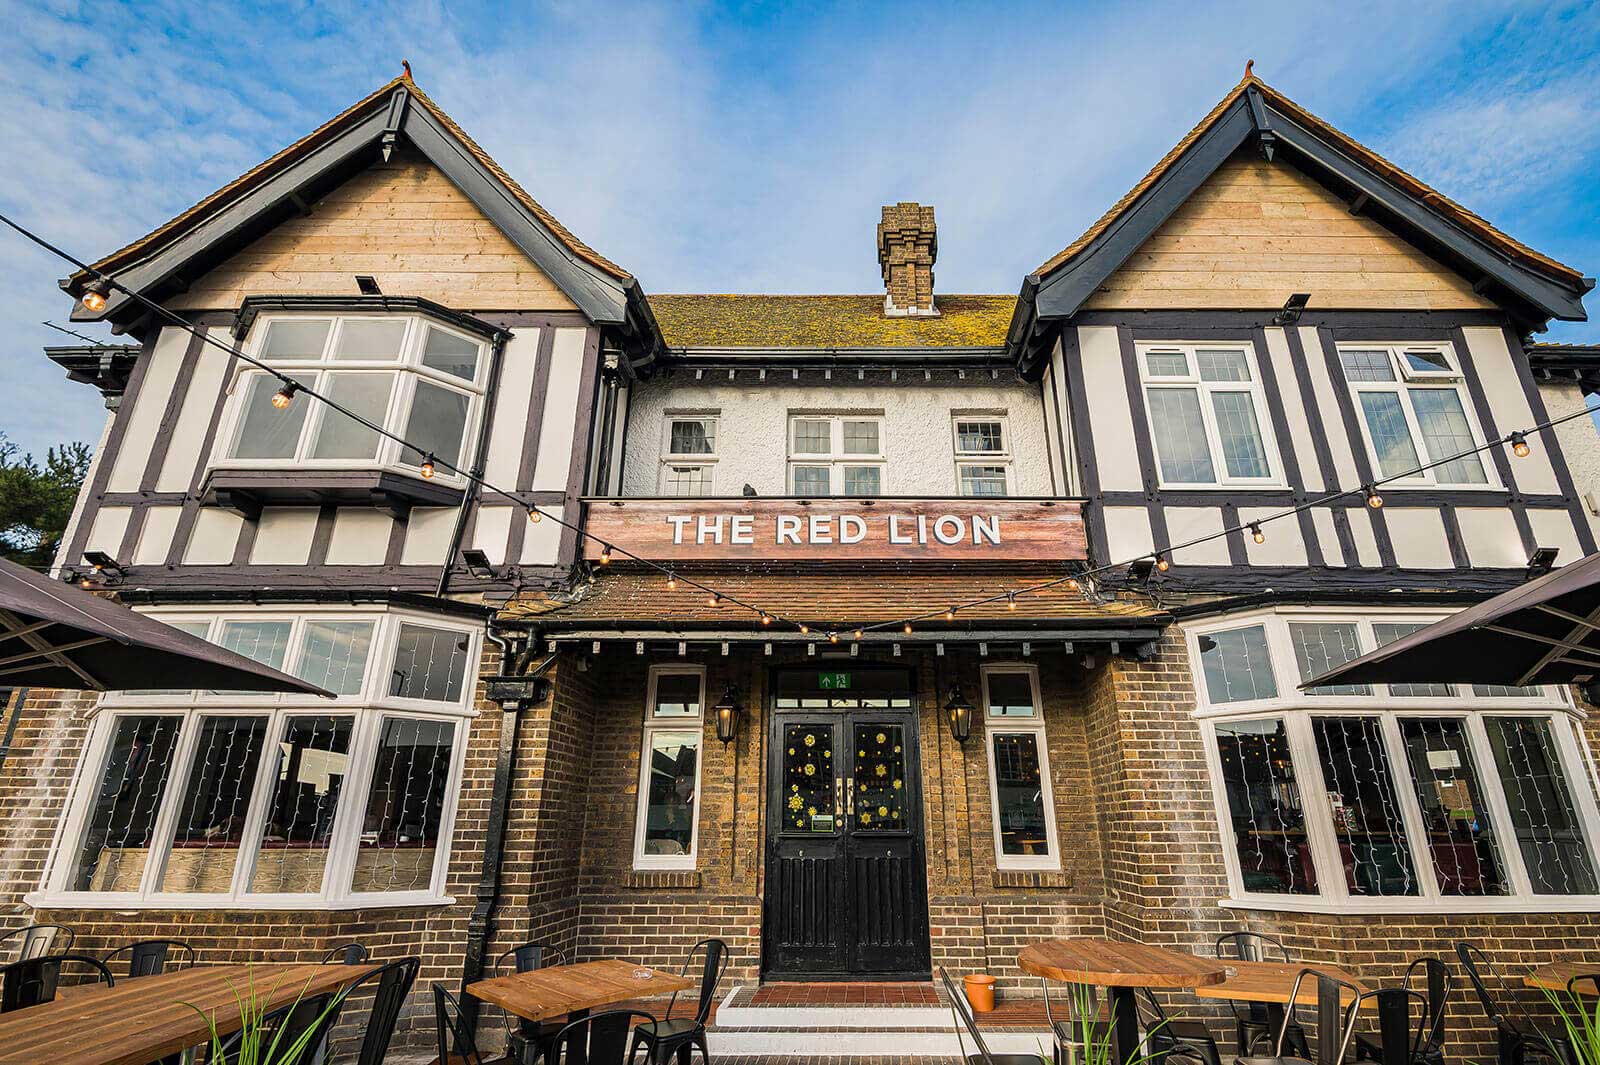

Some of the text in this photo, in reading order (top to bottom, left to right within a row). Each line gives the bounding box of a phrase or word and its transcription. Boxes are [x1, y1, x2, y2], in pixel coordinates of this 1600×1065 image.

[667, 515, 1001, 545] THE RED LION
